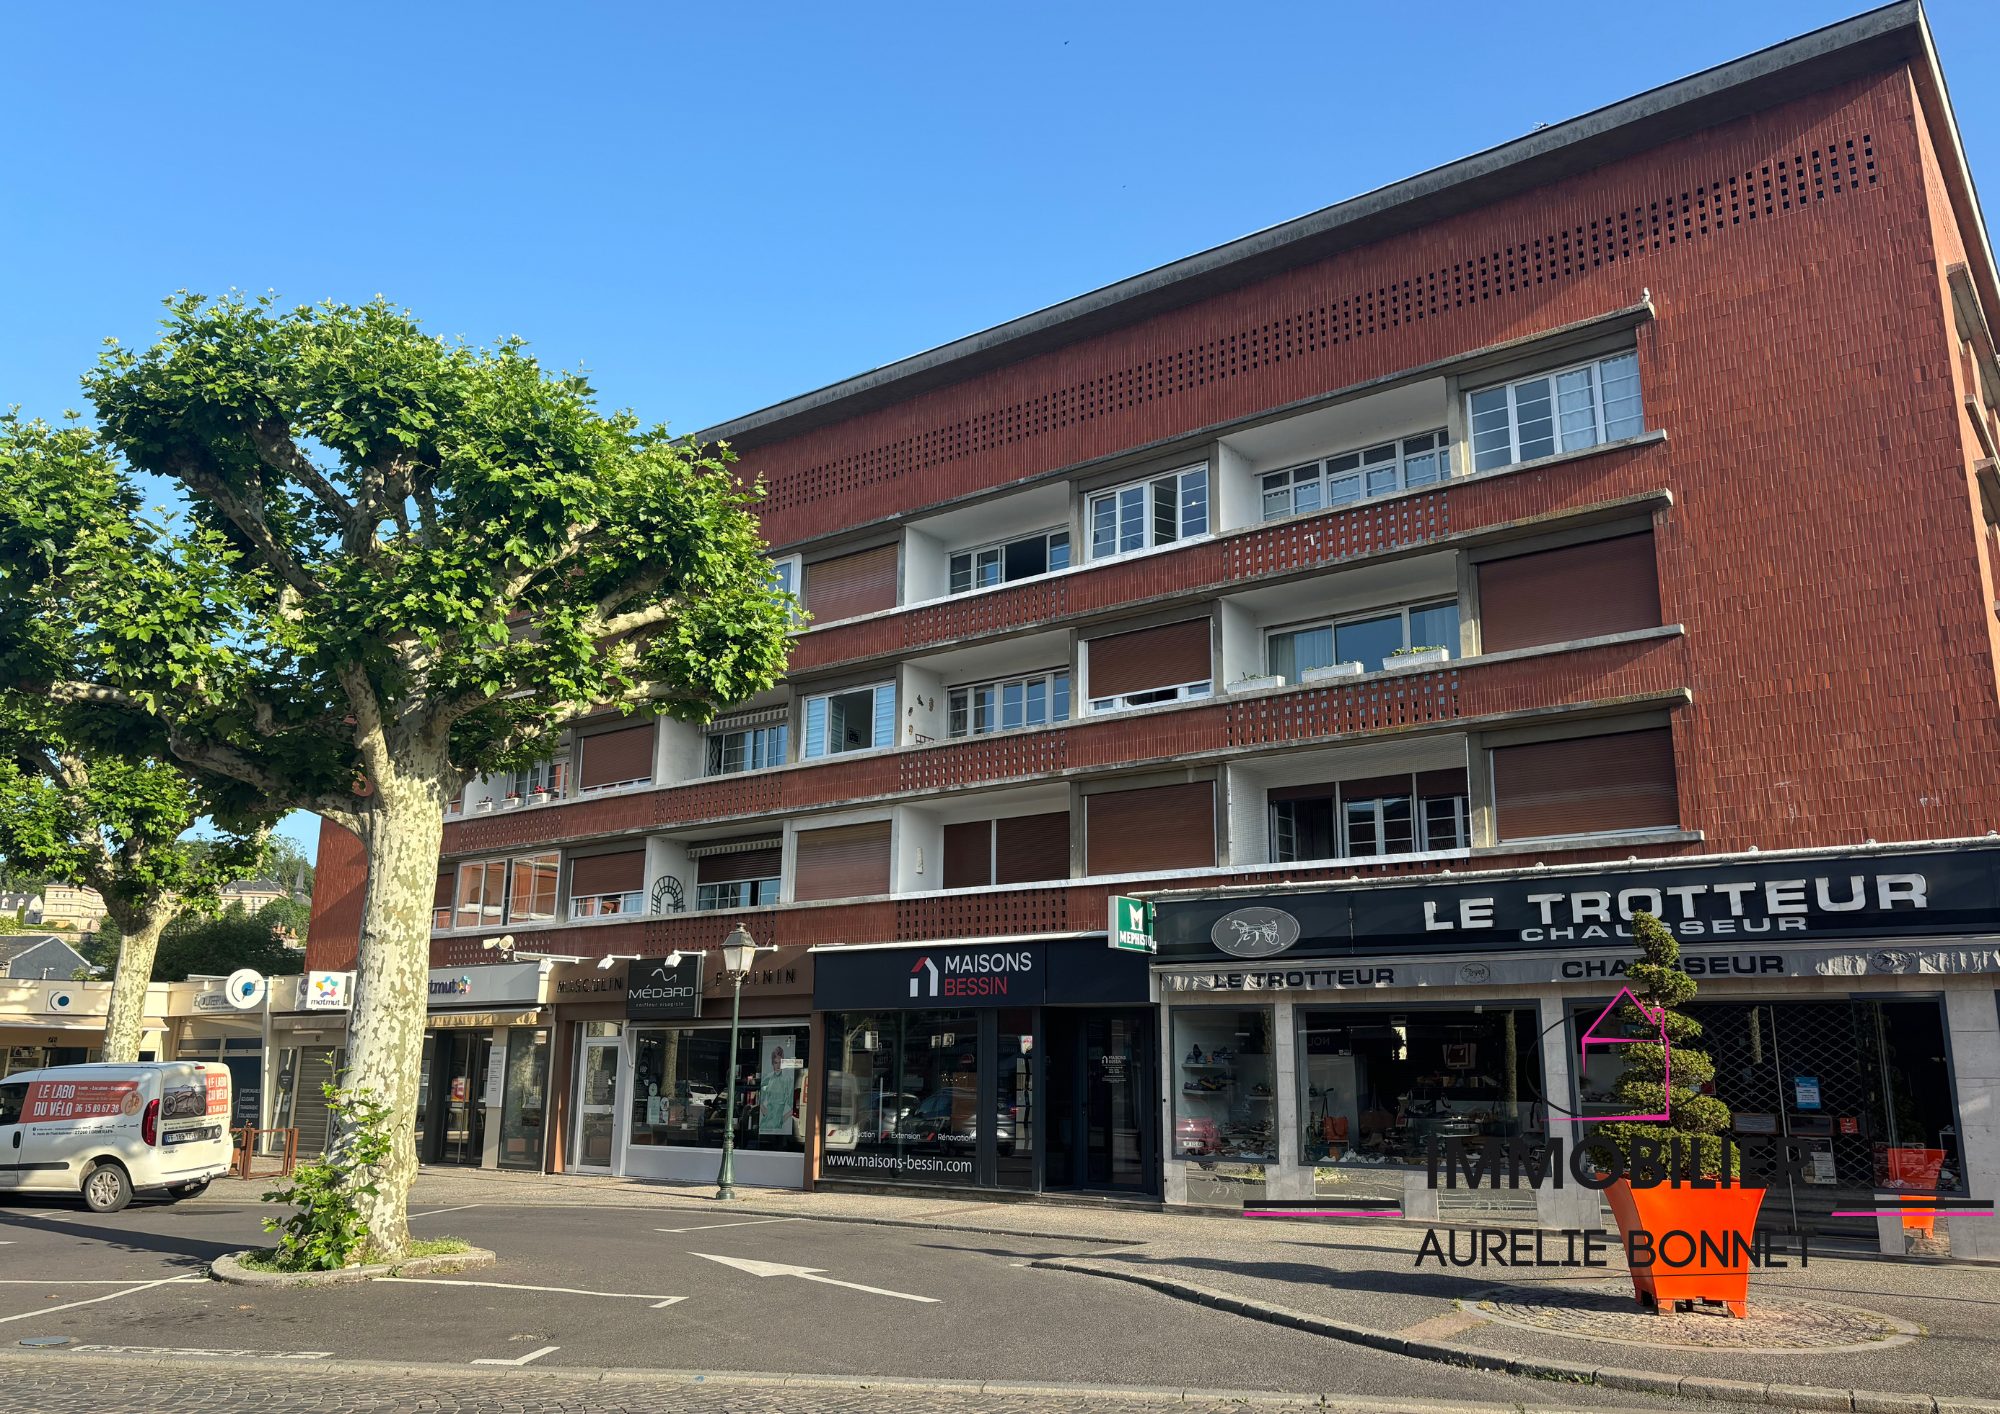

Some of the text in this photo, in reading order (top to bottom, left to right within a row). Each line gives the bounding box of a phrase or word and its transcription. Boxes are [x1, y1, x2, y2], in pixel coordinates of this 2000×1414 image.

[1423, 872, 1928, 931] LE TROTTEUR
[1119, 931, 1153, 947] MEPHISTO
[944, 952, 1032, 974] MAISONS
[1560, 954, 1785, 980] CHASEUR
[428, 978, 457, 994] tmut
[944, 976, 1008, 996] BESSIN
[1213, 968, 1395, 989] LE TROTTEUR
[37, 1084, 51, 1099] LE
[51, 1084, 76, 1099] LABO
[33, 1100, 74, 1116] DU VÉLO
[891, 1131, 921, 1140] Extension
[937, 1133, 974, 1142] Rénovation
[826, 1153, 973, 1174] www.maisons-bessin.com
